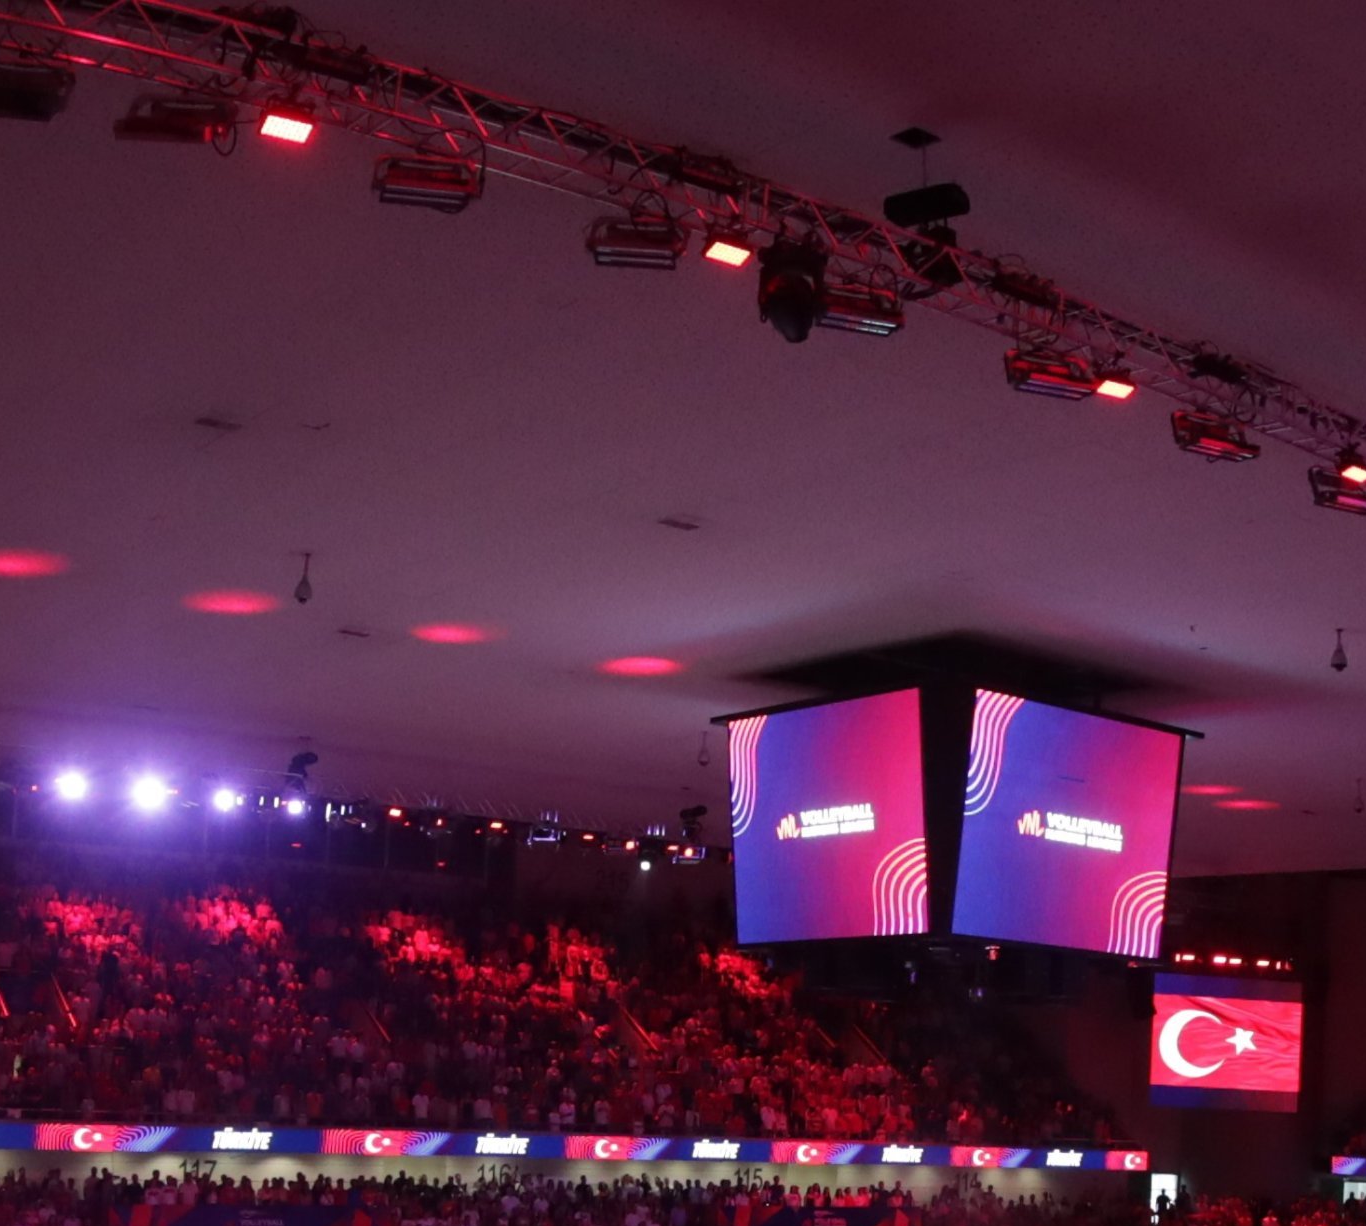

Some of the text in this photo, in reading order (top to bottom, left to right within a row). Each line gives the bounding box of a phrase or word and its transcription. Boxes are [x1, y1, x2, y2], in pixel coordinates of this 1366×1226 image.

[800, 803, 874, 826] VOLLEYBALL
[1046, 812, 1124, 840] VOLLEYBALL
[212, 1127, 272, 1149] TÜRKİYE
[476, 1133, 529, 1154] TÜRKİYE
[180, 1159, 217, 1184] 117
[733, 1168, 764, 1190] 115
